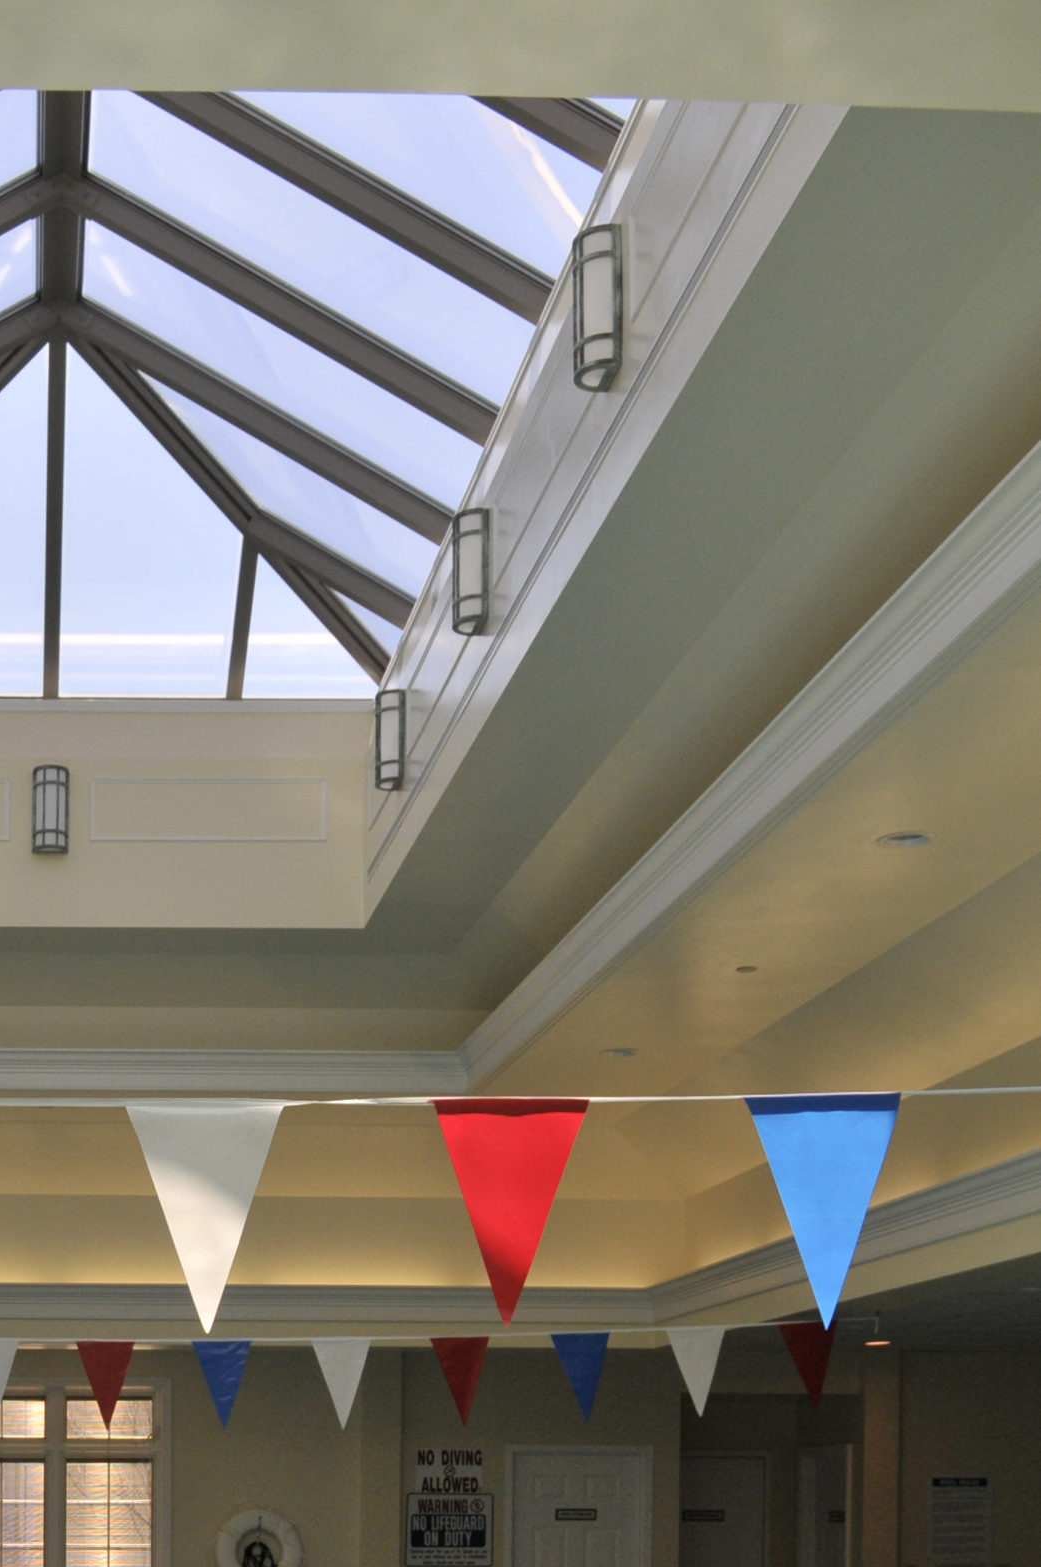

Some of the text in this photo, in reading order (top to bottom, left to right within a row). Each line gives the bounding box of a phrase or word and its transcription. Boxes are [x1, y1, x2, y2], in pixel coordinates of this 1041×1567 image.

[417, 1450, 482, 1466] NO DIVING
[421, 1477, 479, 1492] ALLOWED
[417, 1498, 468, 1513] WARNING
[412, 1515, 485, 1531] NO LIFEGUARD
[424, 1531, 472, 1546] ON DUTY
